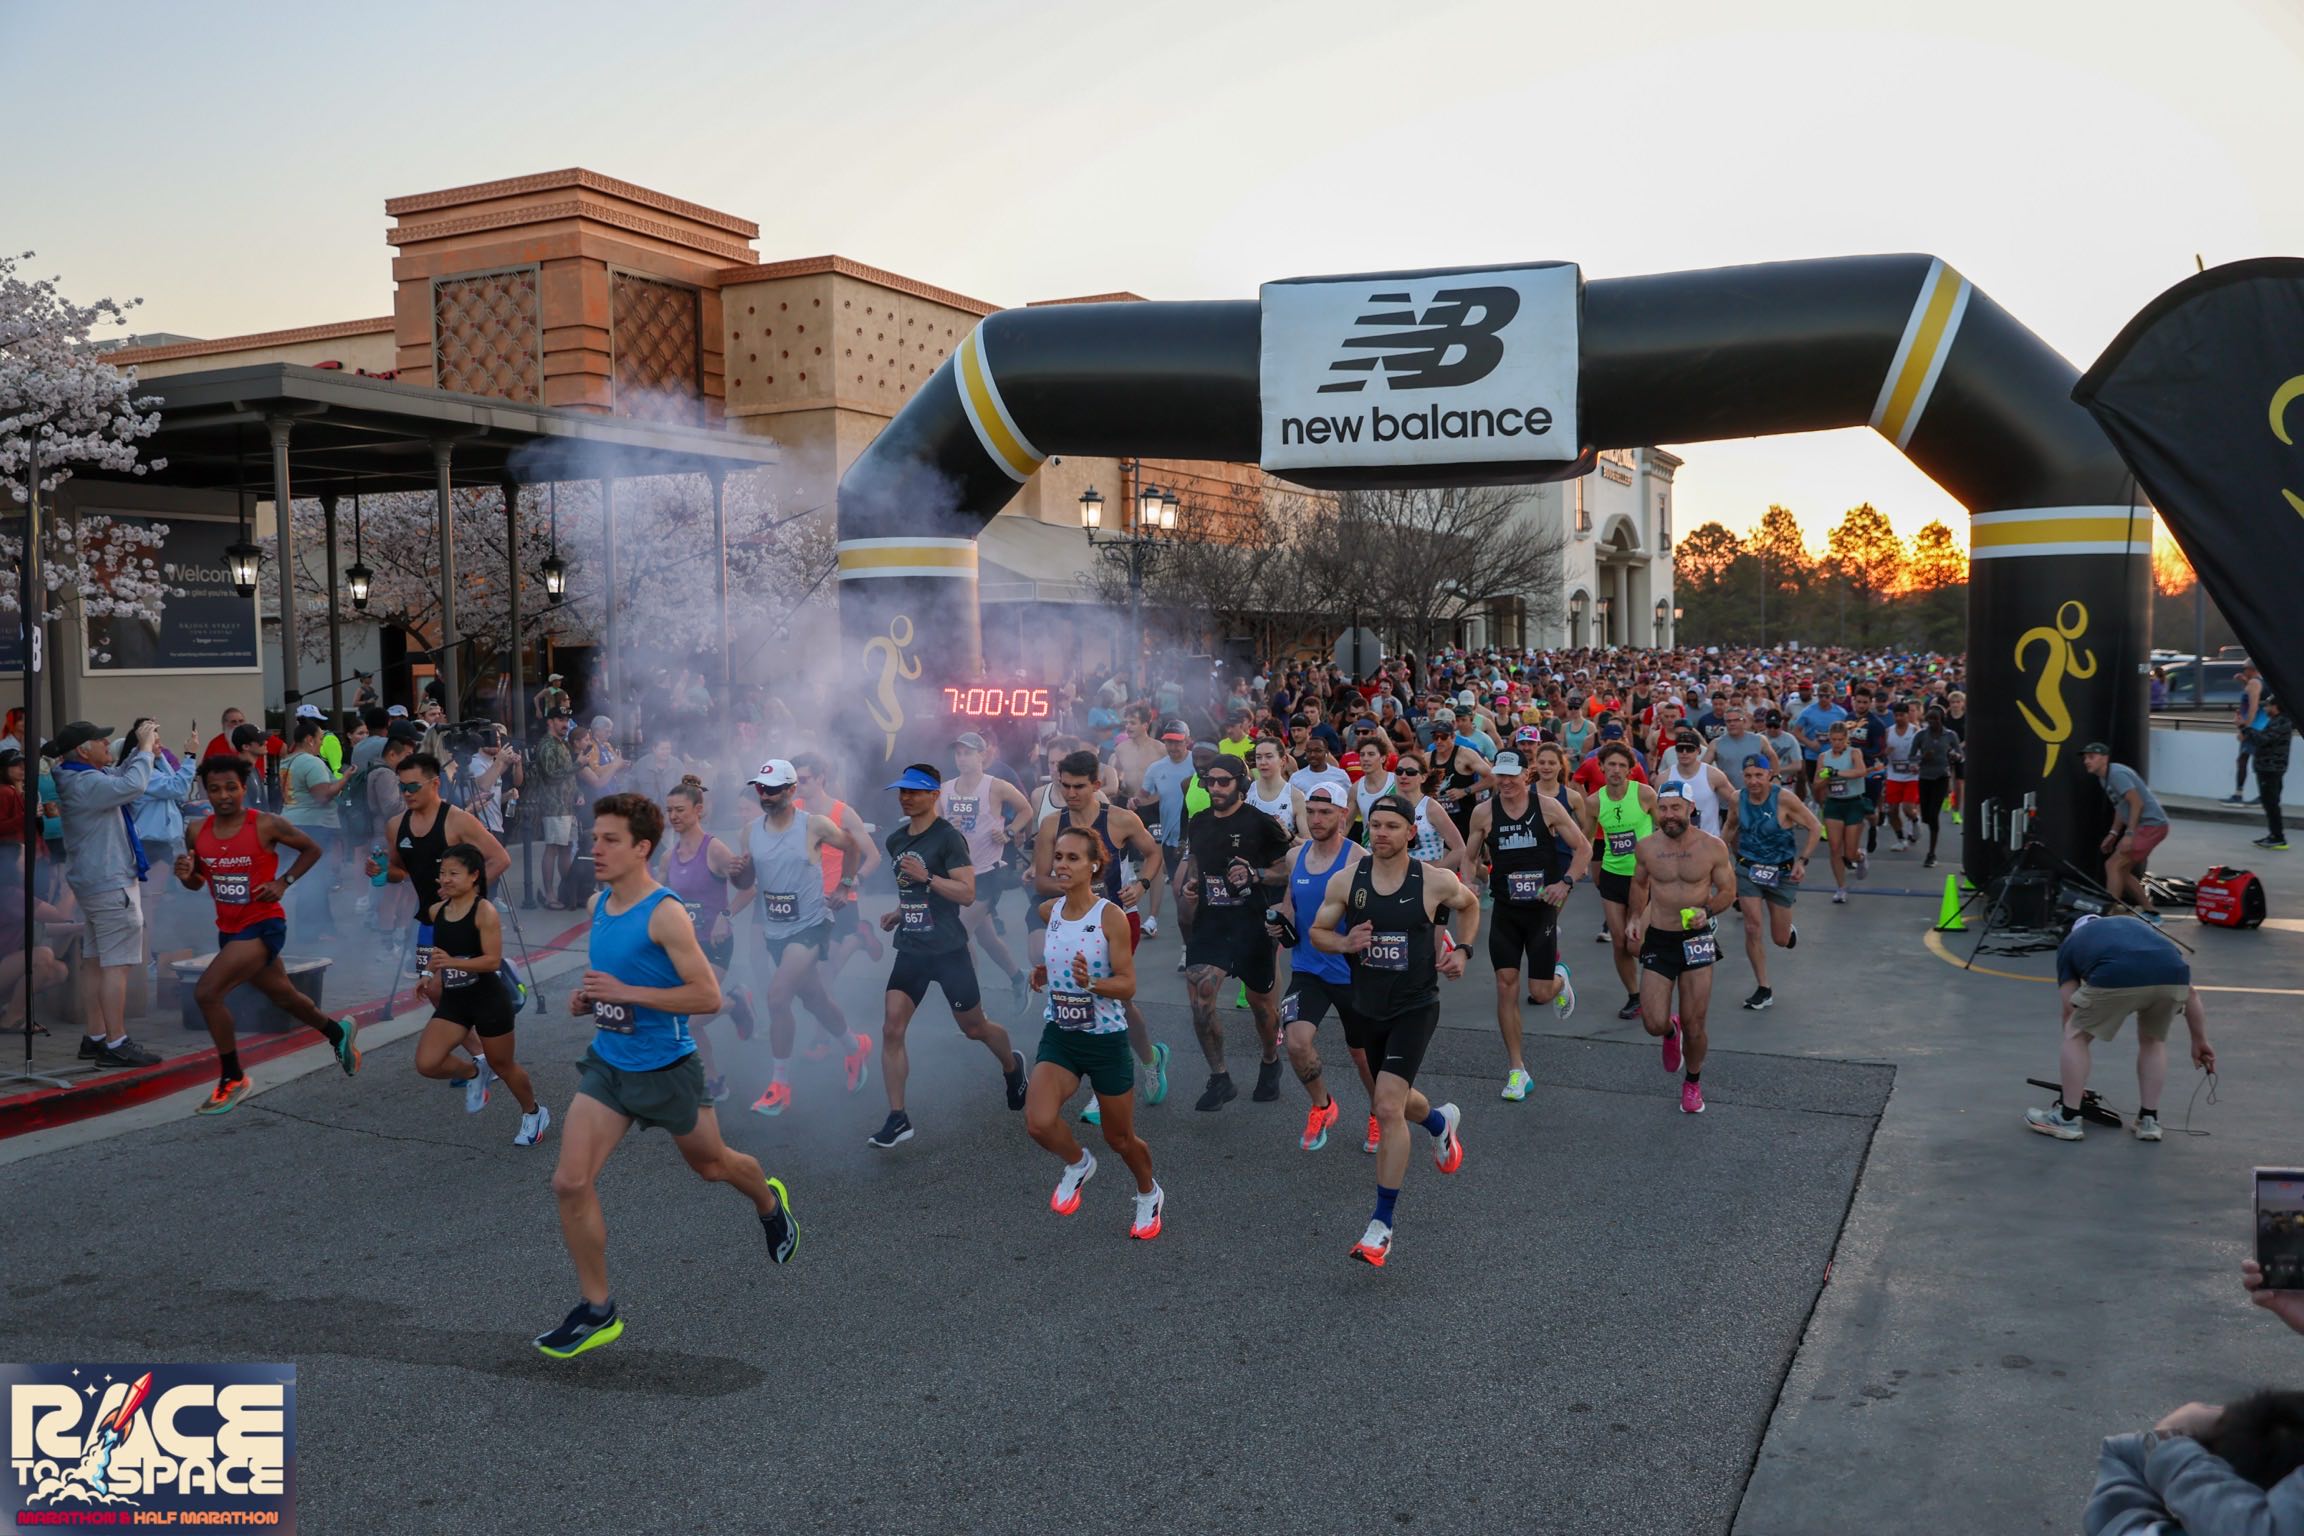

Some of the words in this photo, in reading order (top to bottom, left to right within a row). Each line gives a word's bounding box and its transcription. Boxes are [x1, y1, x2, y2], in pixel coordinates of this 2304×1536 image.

[1282, 415, 1364, 444] new
[1372, 404, 1553, 442] balance
[953, 803, 973, 813] 636
[1612, 839, 1632, 849] 780
[218, 856, 252, 866] ATLANTA
[1755, 869, 1774, 880] 457
[215, 884, 246, 896] 1060
[1516, 881, 1536, 892] 961
[768, 903, 792, 914] 440
[905, 912, 924, 924] 667
[1367, 946, 1400, 960] 1016
[595, 1001, 625, 1021] 900
[1056, 1005, 1088, 1020] 1001
